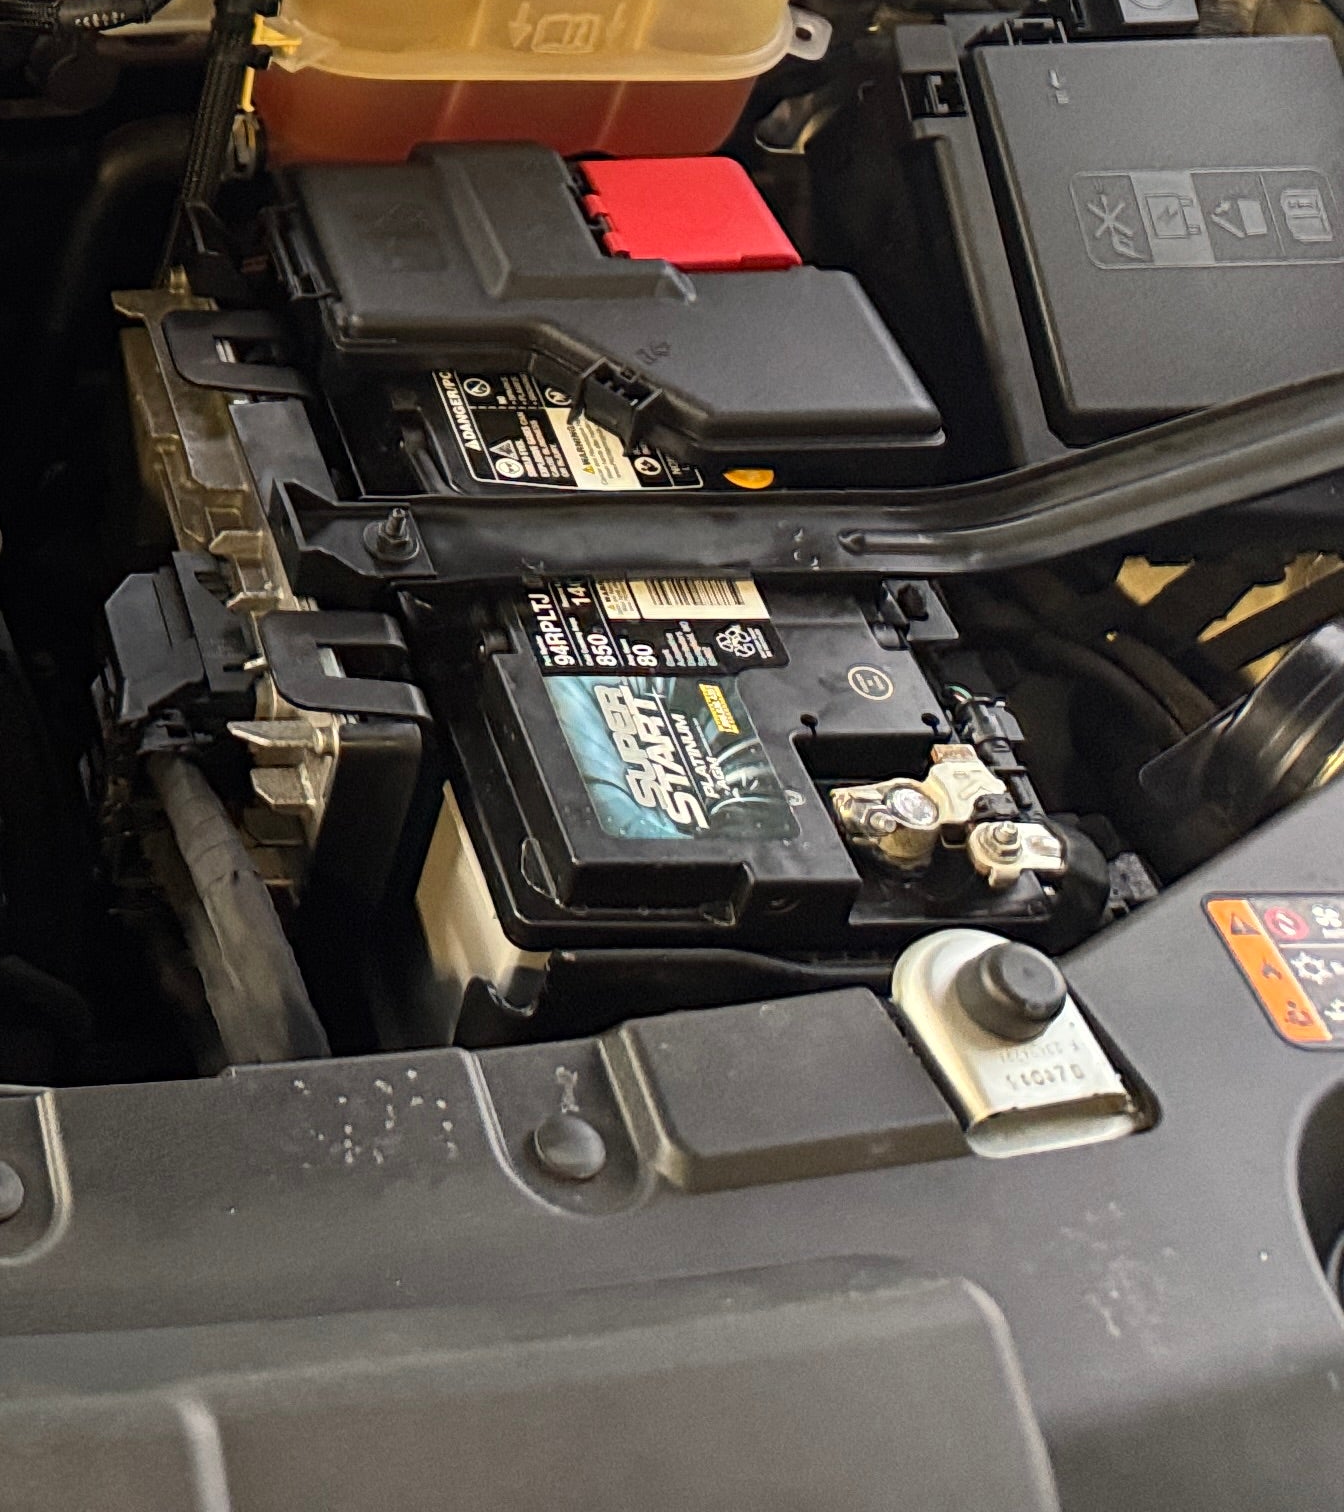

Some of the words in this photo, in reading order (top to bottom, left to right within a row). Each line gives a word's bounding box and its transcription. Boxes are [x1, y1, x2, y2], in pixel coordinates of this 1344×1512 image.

[566, 582, 591, 606] 14
[528, 593, 575, 667] 94RPLTJ
[587, 634, 617, 667] 850
[632, 644, 658, 667] 80
[594, 685, 667, 809] SUPER
[619, 684, 710, 829] START
[670, 713, 720, 799] PLATINUM
[706, 756, 731, 791] AGM
